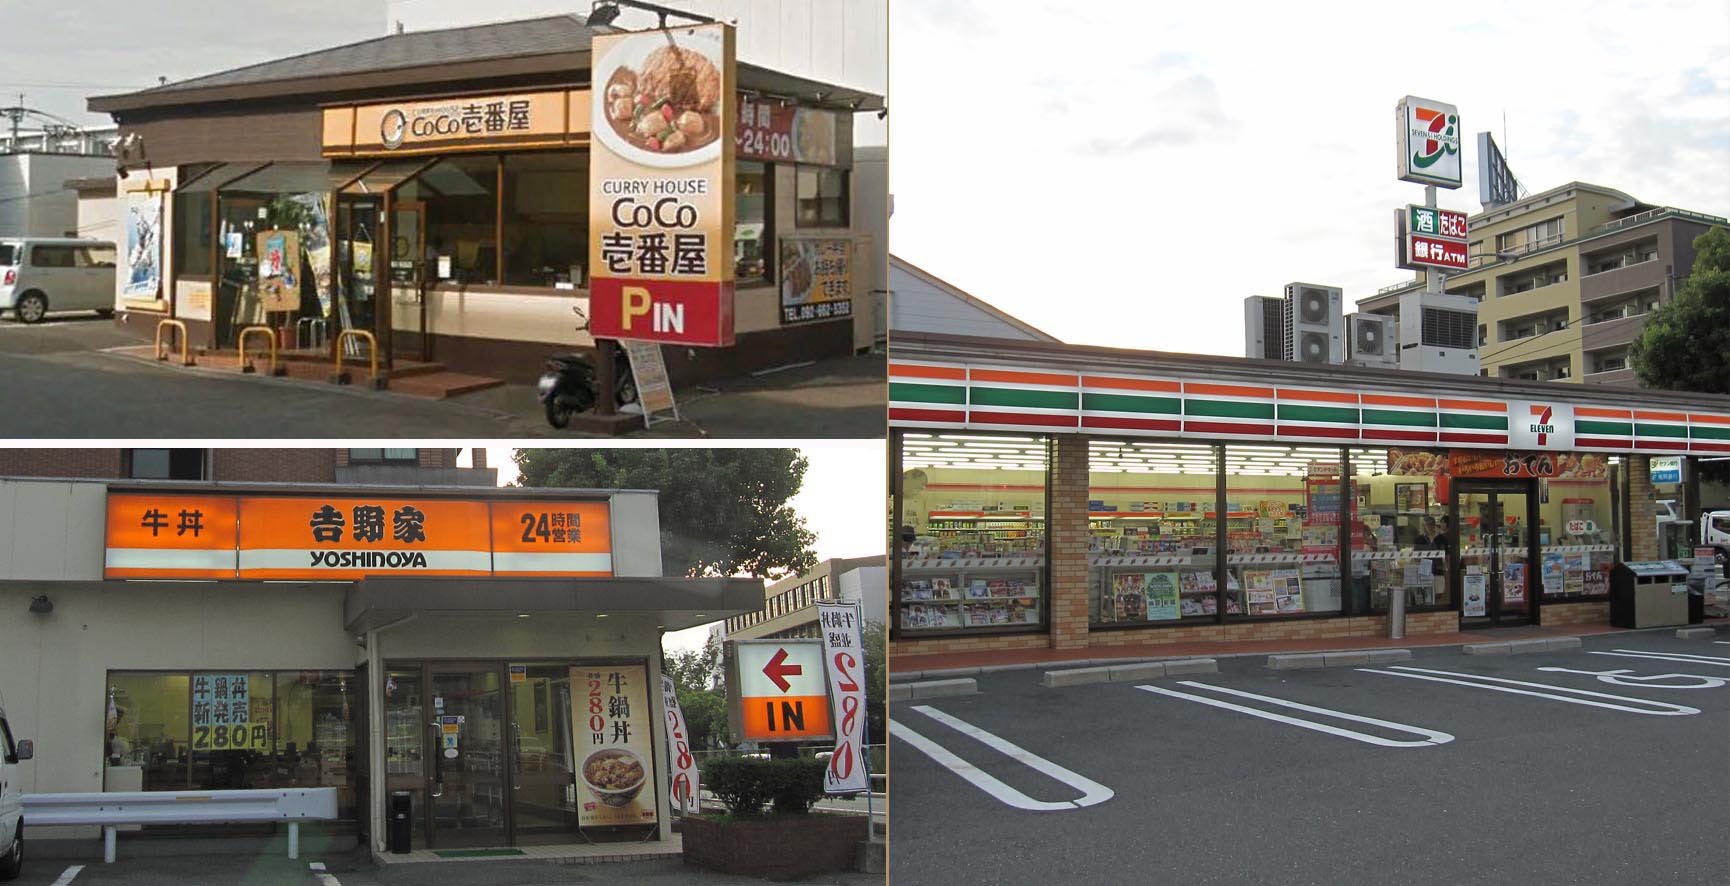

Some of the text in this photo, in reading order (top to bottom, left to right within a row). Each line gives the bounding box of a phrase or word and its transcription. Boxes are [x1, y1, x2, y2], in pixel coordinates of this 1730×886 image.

[603, 180, 707, 193] CURRY HOUSE
[612, 198, 697, 228] CoCo
[1416, 209, 1434, 232] 酒
[1440, 213, 1466, 236] たばこ
[602, 232, 706, 275] 壱番屋
[141, 508, 204, 537] 牛丼
[310, 551, 427, 568] YOSHINOYA
[194, 677, 247, 699] 牛鍋丼
[194, 701, 247, 725] 新発売
[588, 680, 605, 745] 280円
[607, 672, 632, 744] 牛鍋丼
[766, 701, 805, 732] IN
[194, 724, 267, 749] 280円
